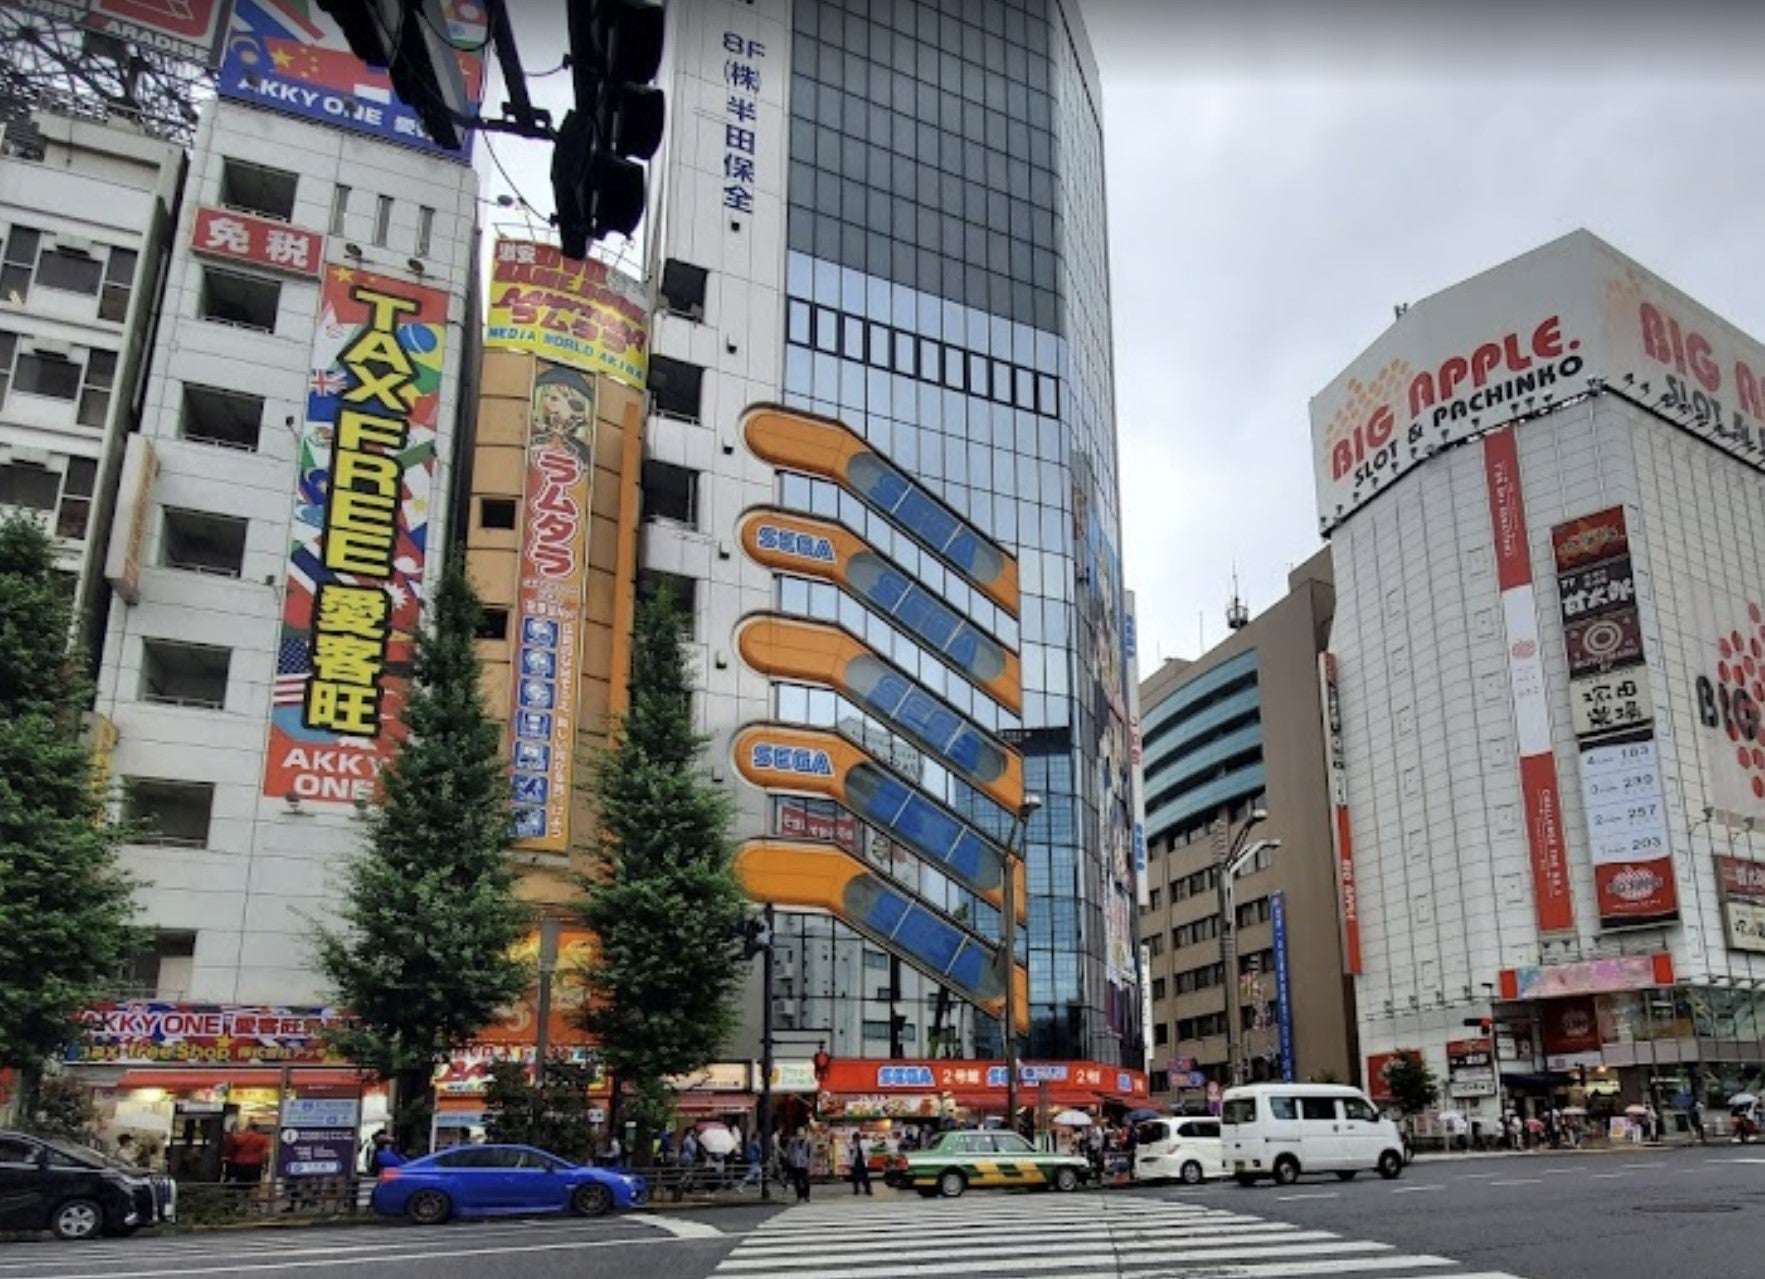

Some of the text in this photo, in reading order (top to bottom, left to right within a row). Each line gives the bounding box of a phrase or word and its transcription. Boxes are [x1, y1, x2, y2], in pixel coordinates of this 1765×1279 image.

[724, 32, 765, 58] 8F
[205, 216, 312, 269] 免税
[340, 286, 420, 413] TAX
[487, 327, 537, 342] MEDIA
[544, 332, 595, 356] WORLD
[1637, 302, 1721, 393] BIG
[1332, 404, 1395, 483] BIG
[1354, 355, 1583, 489] SLOT & PACHINKO
[324, 407, 409, 578] FREE
[530, 450, 580, 578] ラムタラ
[758, 526, 836, 562] SEGA
[1696, 675, 1762, 742] BIG
[292, 774, 376, 801] ONE
[753, 743, 834, 776] SEGA
[164, 1014, 221, 1035] ONE
